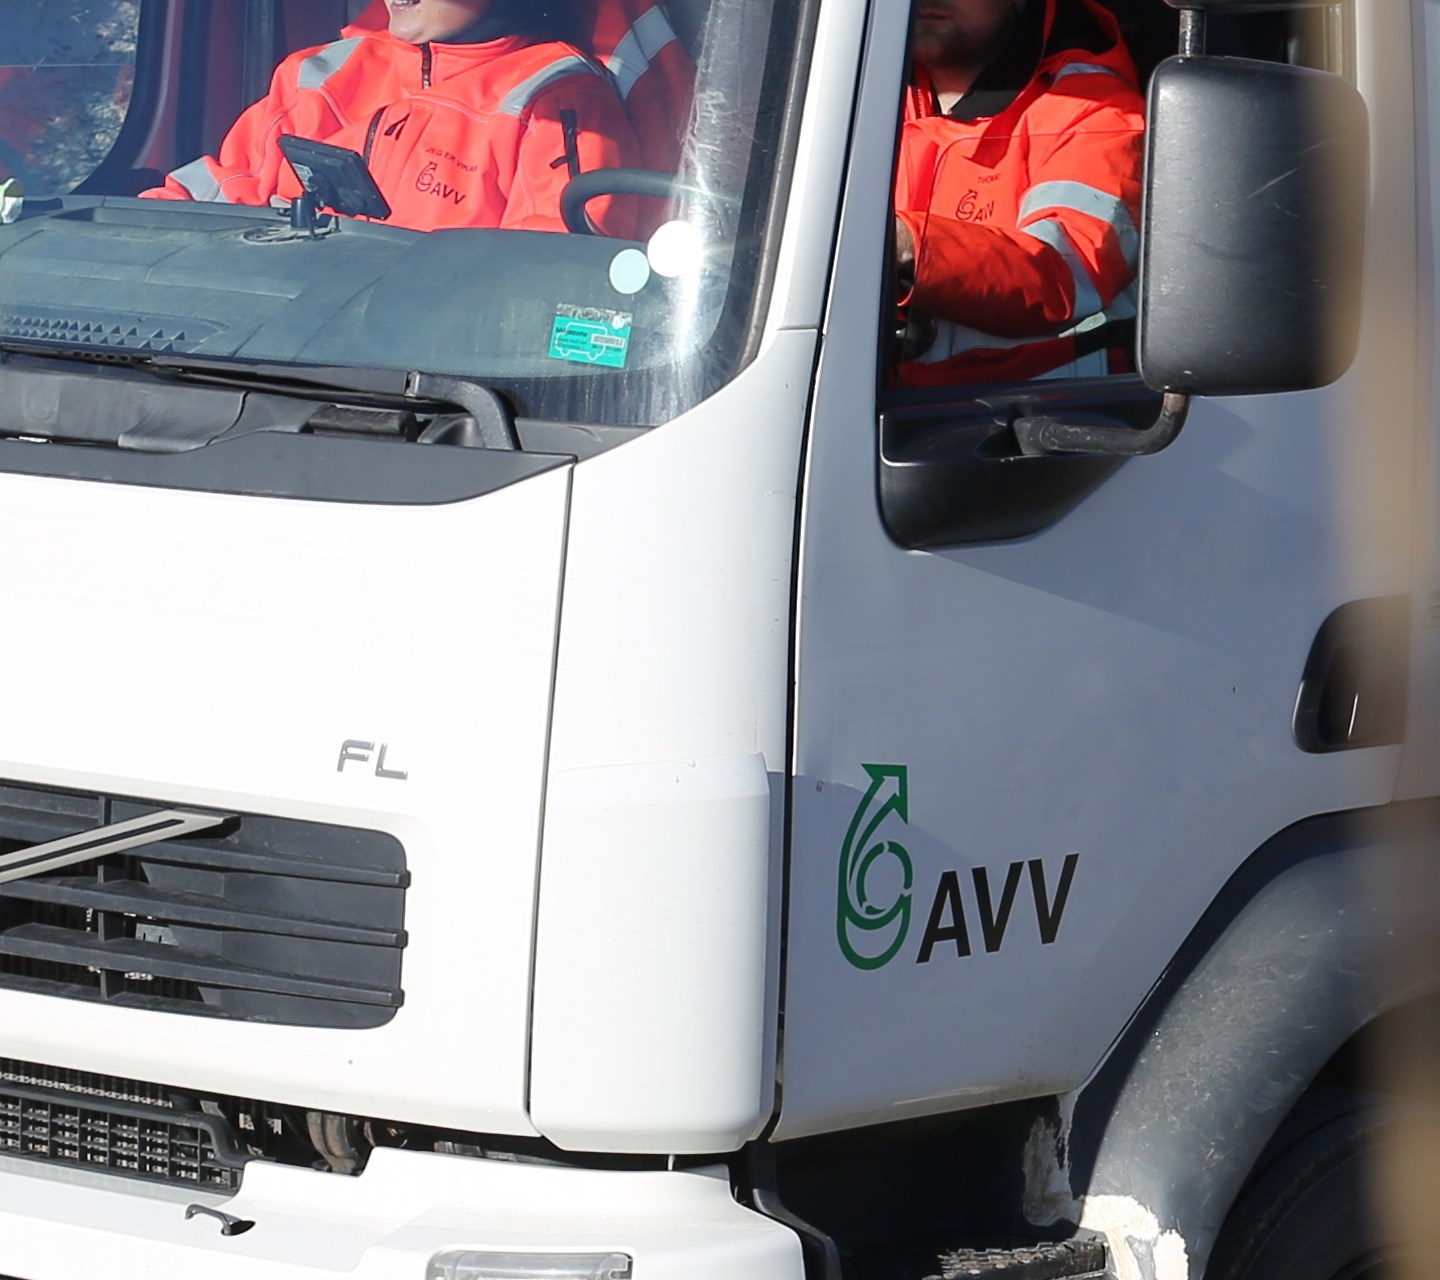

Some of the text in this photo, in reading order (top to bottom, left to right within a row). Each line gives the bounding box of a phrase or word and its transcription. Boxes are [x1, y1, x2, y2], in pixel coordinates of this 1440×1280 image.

[429, 182, 466, 205] AVV
[337, 739, 408, 780] FL
[916, 853, 1080, 964] AVV
